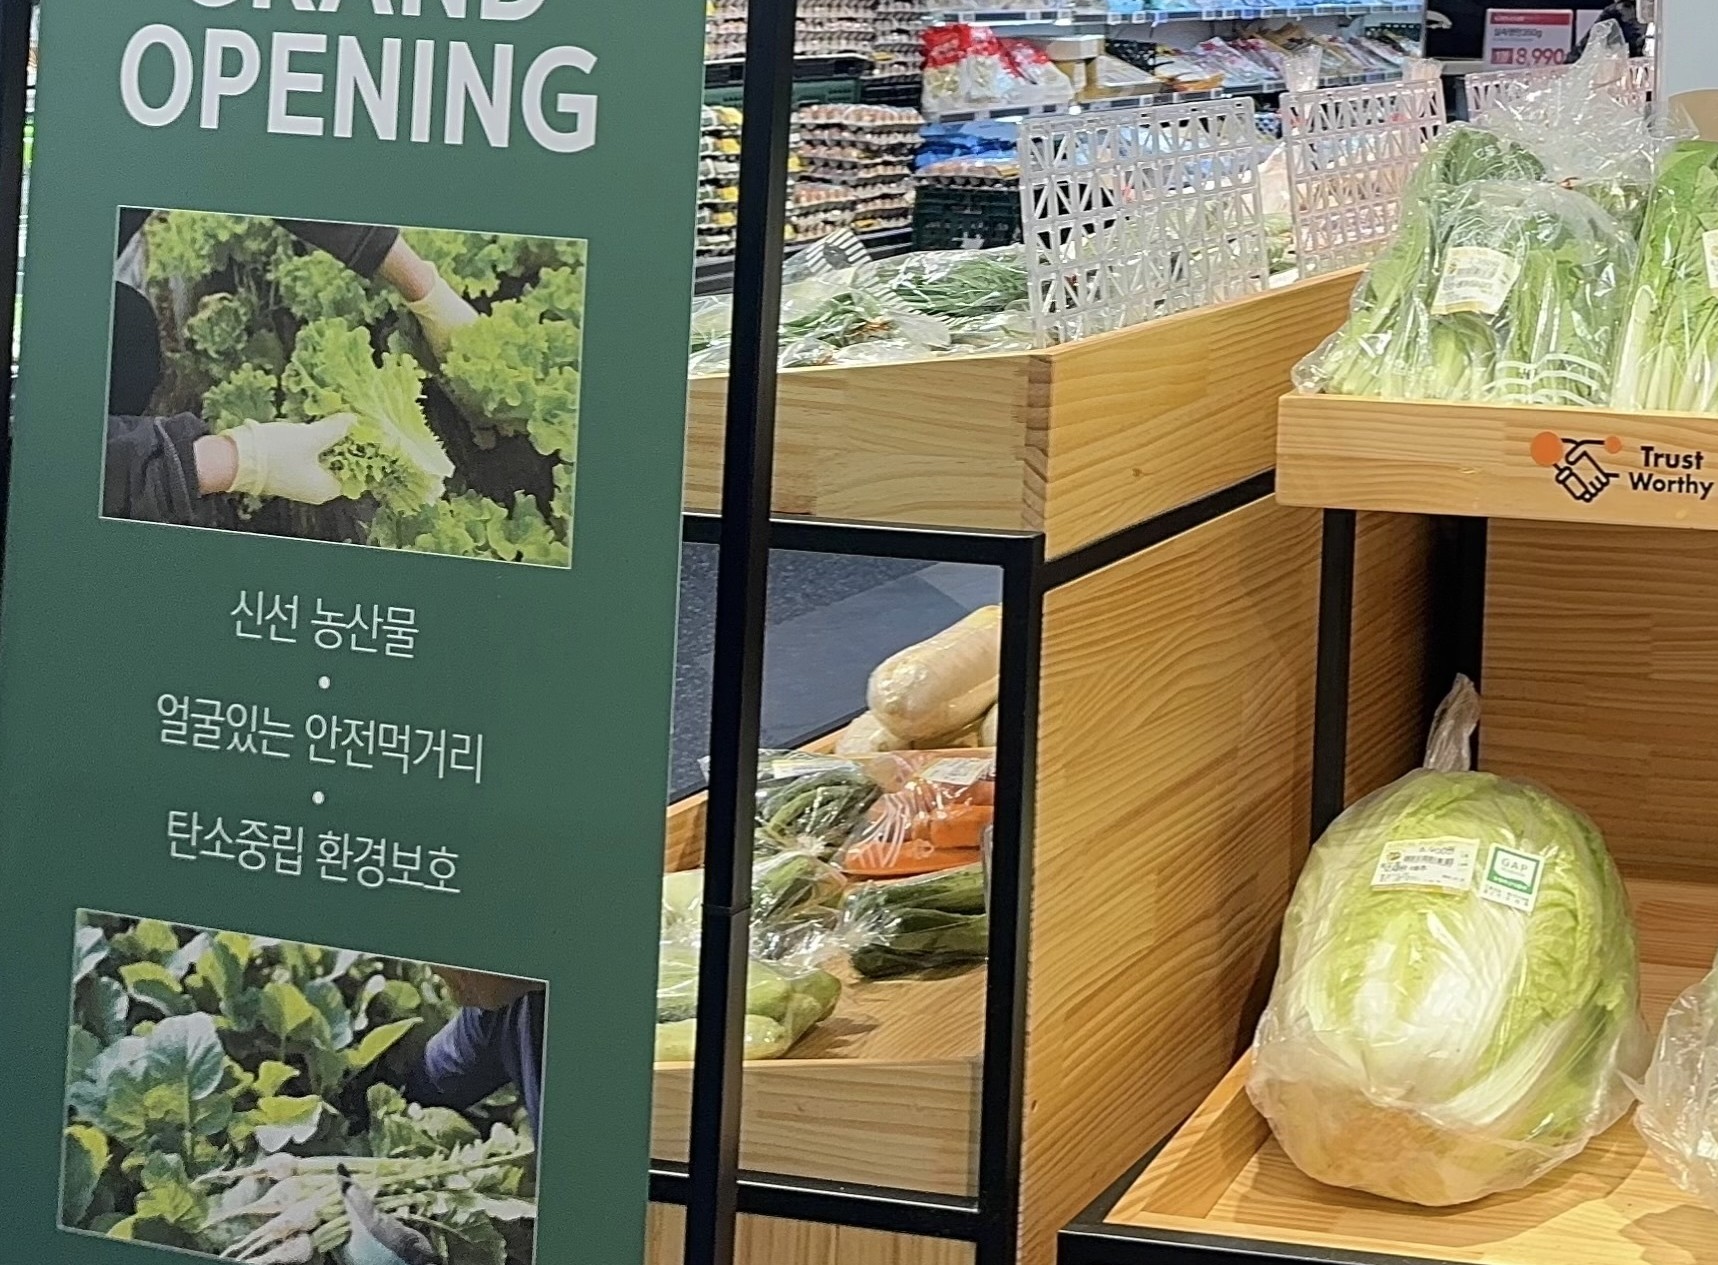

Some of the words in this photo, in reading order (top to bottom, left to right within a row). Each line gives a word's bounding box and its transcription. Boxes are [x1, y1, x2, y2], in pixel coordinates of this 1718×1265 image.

[1516, 47, 1564, 67] 8,990
[119, 23, 599, 154] OPENING
[1640, 445, 1704, 470] Trust
[1628, 472, 1714, 500] Worthy
[230, 589, 299, 644] 신선
[310, 598, 419, 658] 농산물
[157, 693, 294, 759] 얼굴있는
[304, 714, 485, 784] 안전먹거리
[167, 810, 304, 876] 탄소중립
[315, 830, 461, 894] 환경보호
[1501, 857, 1528, 872] GAP
